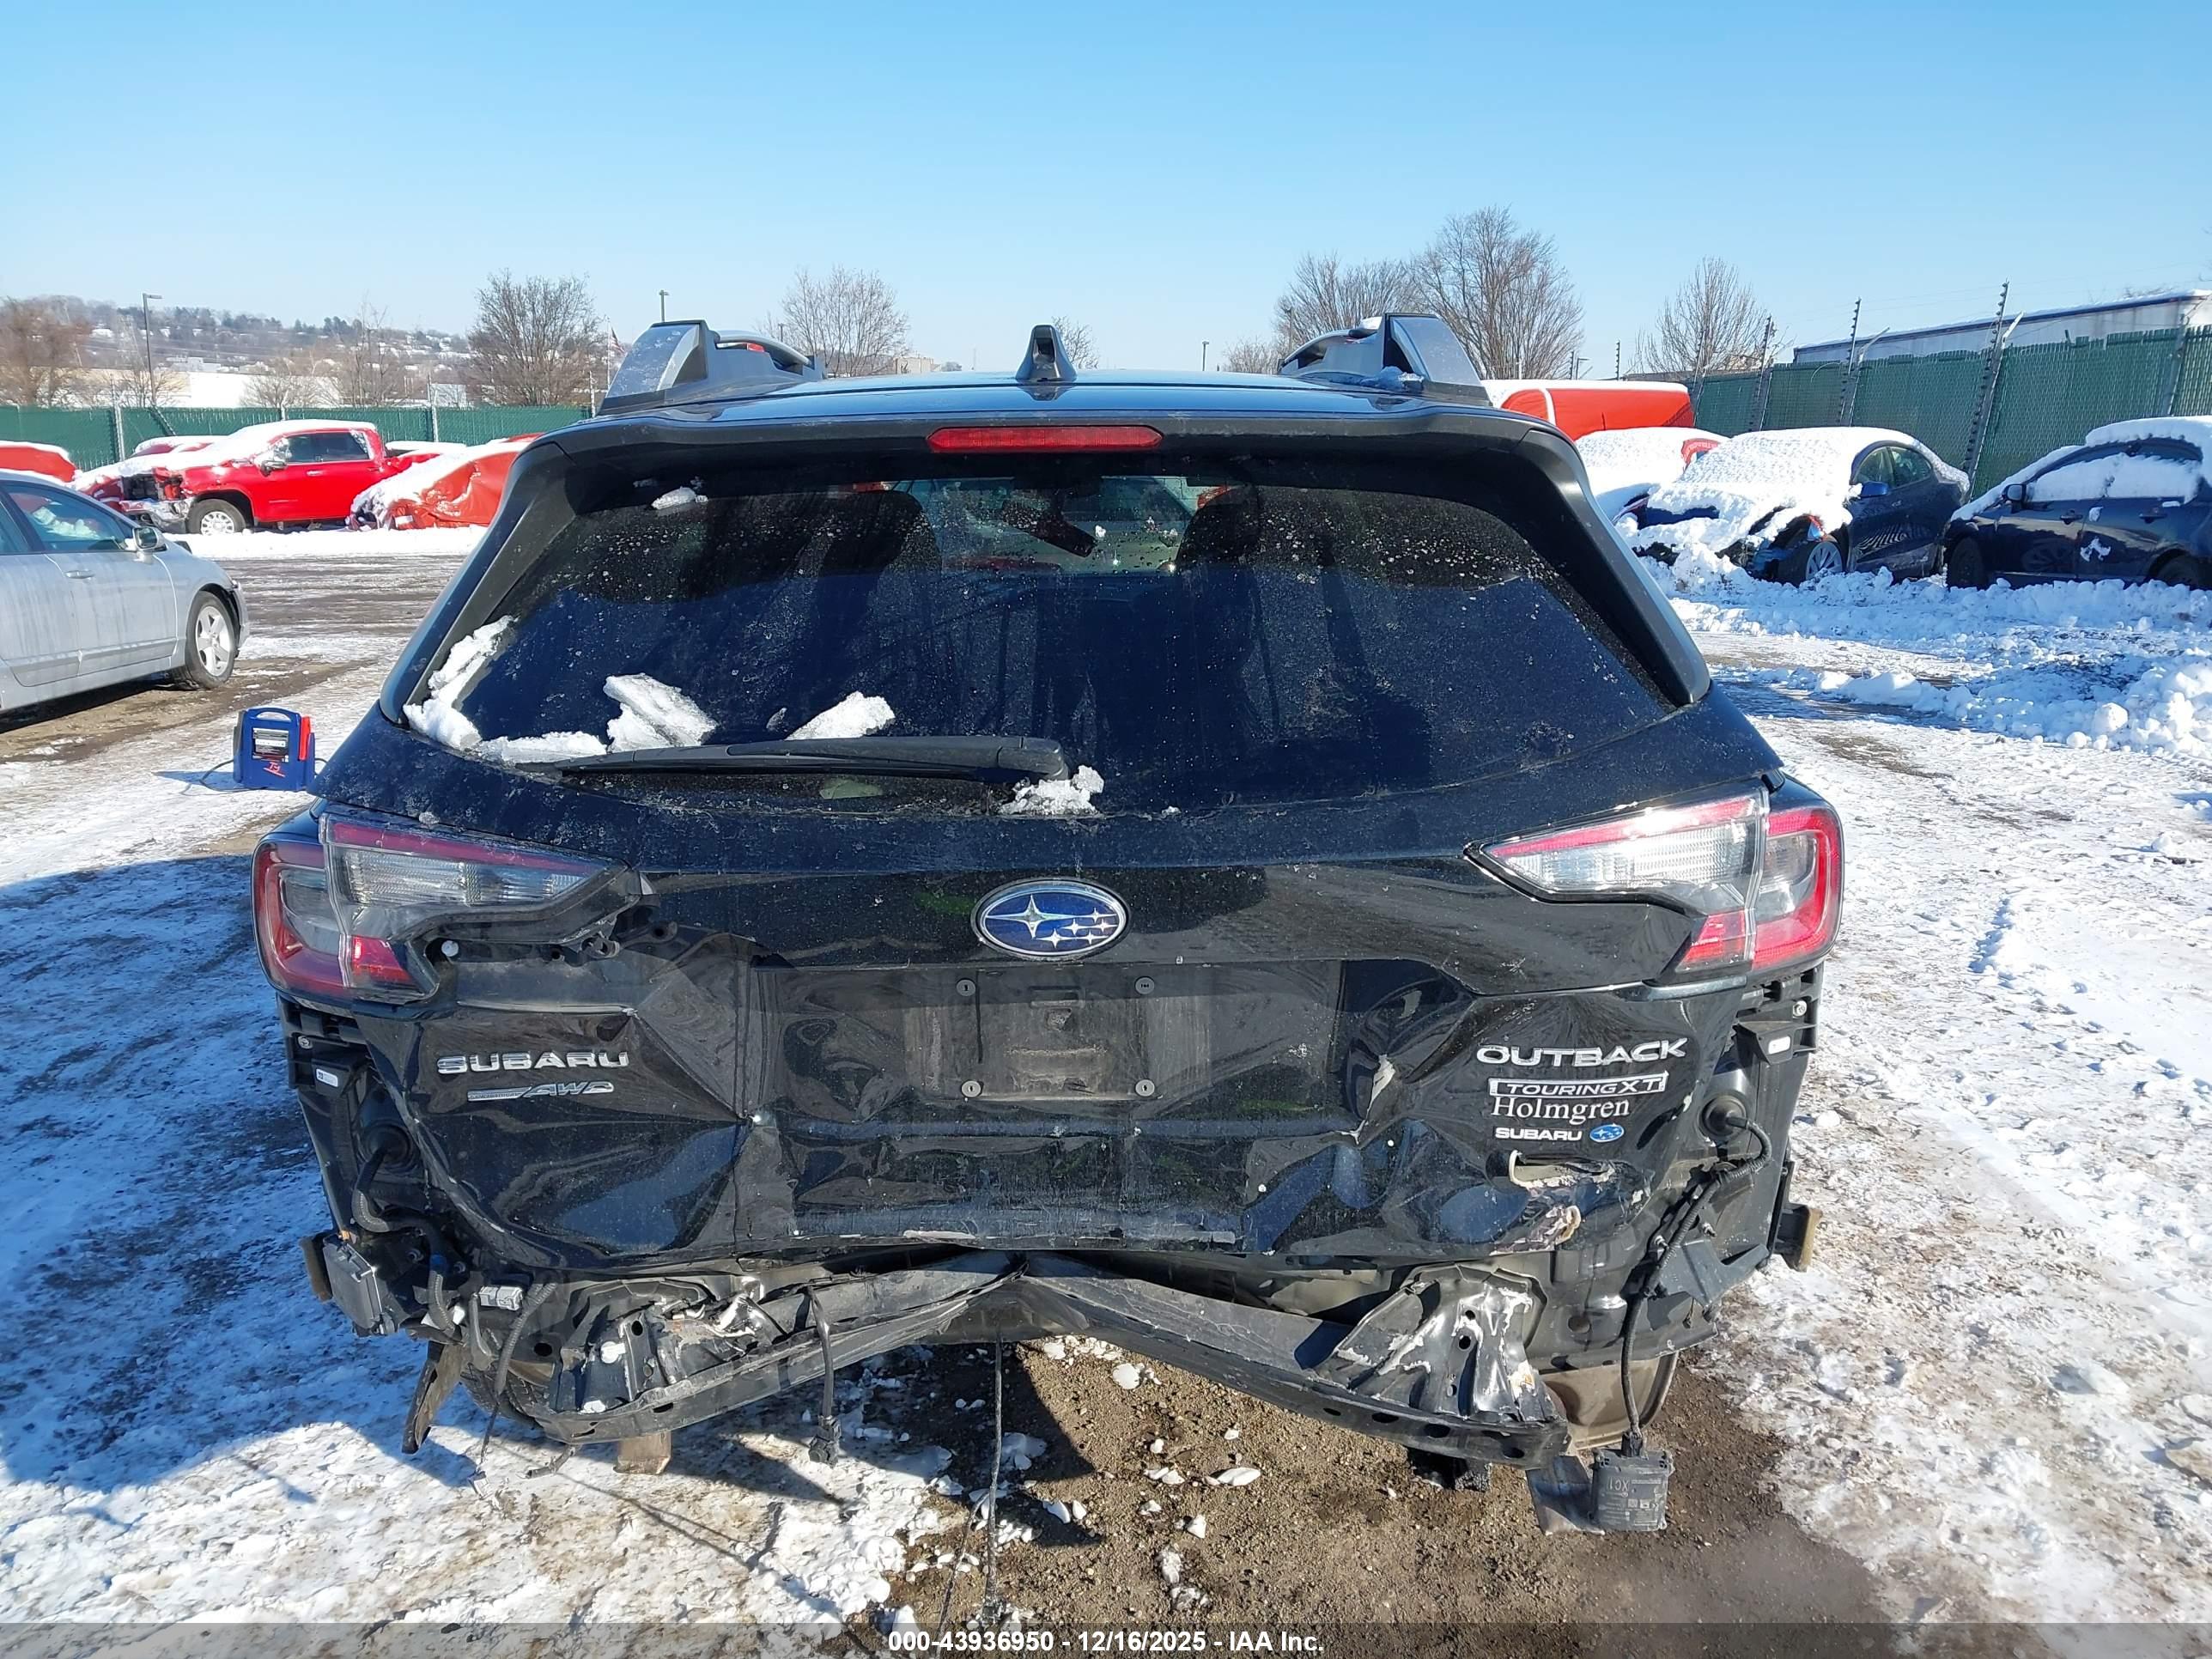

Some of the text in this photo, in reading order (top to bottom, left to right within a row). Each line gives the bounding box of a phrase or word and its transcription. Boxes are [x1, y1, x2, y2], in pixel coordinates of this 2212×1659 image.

[436, 1051, 629, 1074] SUBARU
[1476, 1037, 1688, 1066] OUTBACK
[523, 1081, 615, 1098] AWD
[1491, 1096, 1630, 1125] Holmgren
[1495, 1127, 1583, 1141] SUBARU
